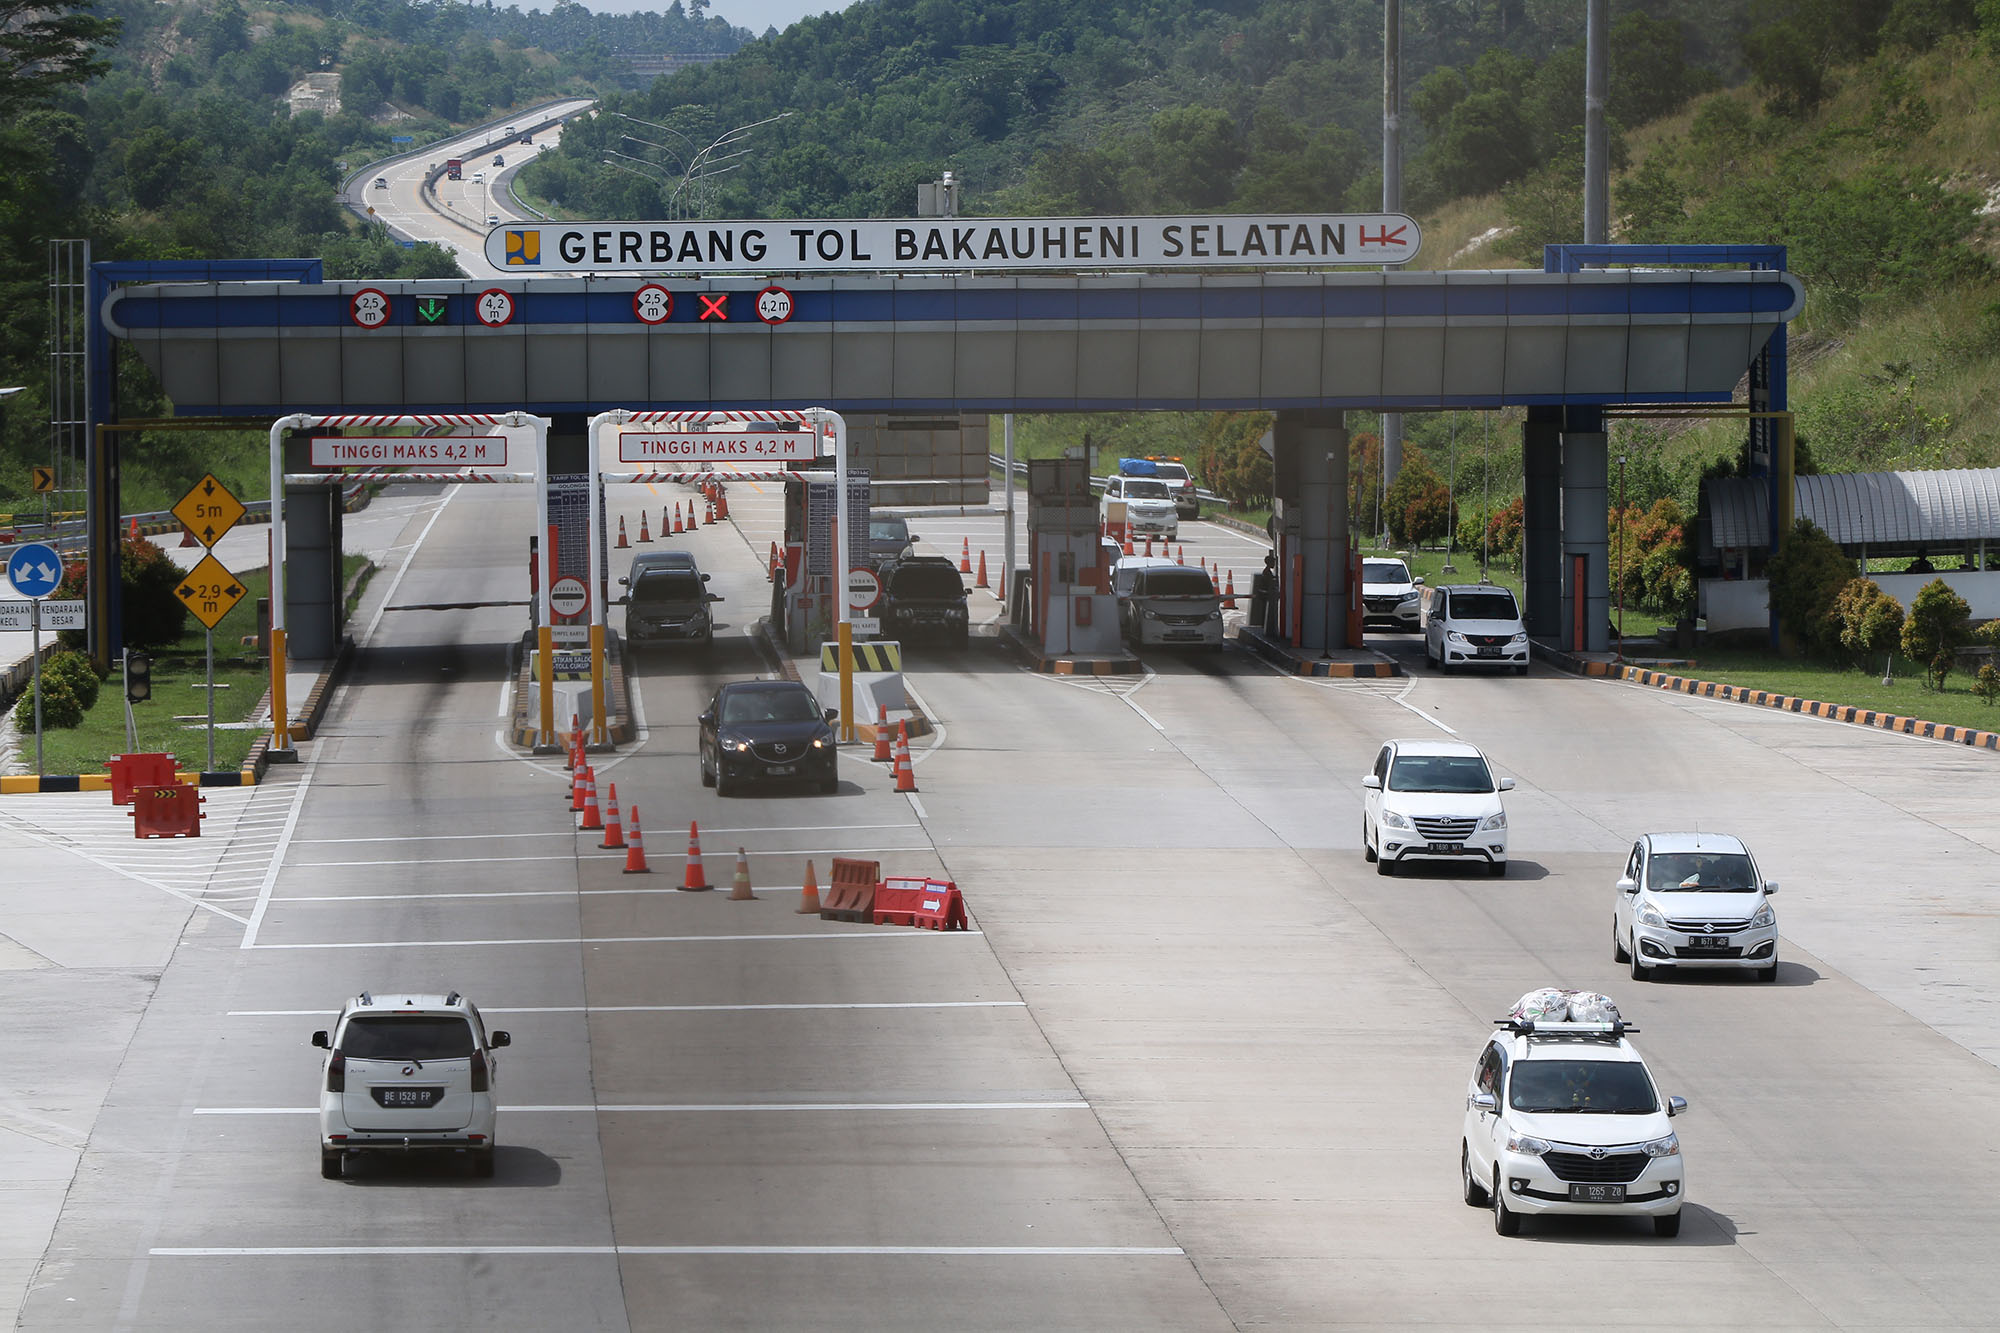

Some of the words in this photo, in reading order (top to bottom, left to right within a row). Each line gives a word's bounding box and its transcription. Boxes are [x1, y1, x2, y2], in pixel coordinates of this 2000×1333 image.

[559, 229, 768, 264] GERBANG
[789, 228, 872, 262] TOL
[894, 225, 1139, 261] BAKAUHENI
[1162, 223, 1347, 258] SELATAN
[362, 297, 379, 310] 2,5
[485, 298, 504, 310] 4,2
[644, 293, 661, 305] 2,5
[647, 307, 659, 317] m
[760, 300, 777, 314] 4,2
[778, 303, 790, 312] m
[365, 312, 376, 321] m
[489, 310, 500, 319] m
[332, 444, 387, 458] TINGGI
[393, 444, 439, 458] MAKS
[444, 444, 467, 461] 4,2
[475, 444, 487, 458] M
[640, 440, 696, 455] TINGGI
[702, 440, 748, 454] MAKS
[754, 439, 777, 456] 4,2
[784, 439, 796, 453] M
[196, 503, 206, 518] 5
[208, 505, 222, 518] m
[198, 584, 221, 600] 2,9
[0, 605, 30, 615] DARAAN
[41, 604, 83, 615] KENDARAAN
[203, 601, 218, 613] m
[0, 617, 19, 626] KECIL
[52, 616, 74, 625] BESAR
[384, 1091, 395, 1101] BE
[399, 1091, 417, 1101] 1528
[421, 1091, 431, 1101] FP
[1574, 1186, 1580, 1196] A
[1588, 1186, 1605, 1196] 1265
